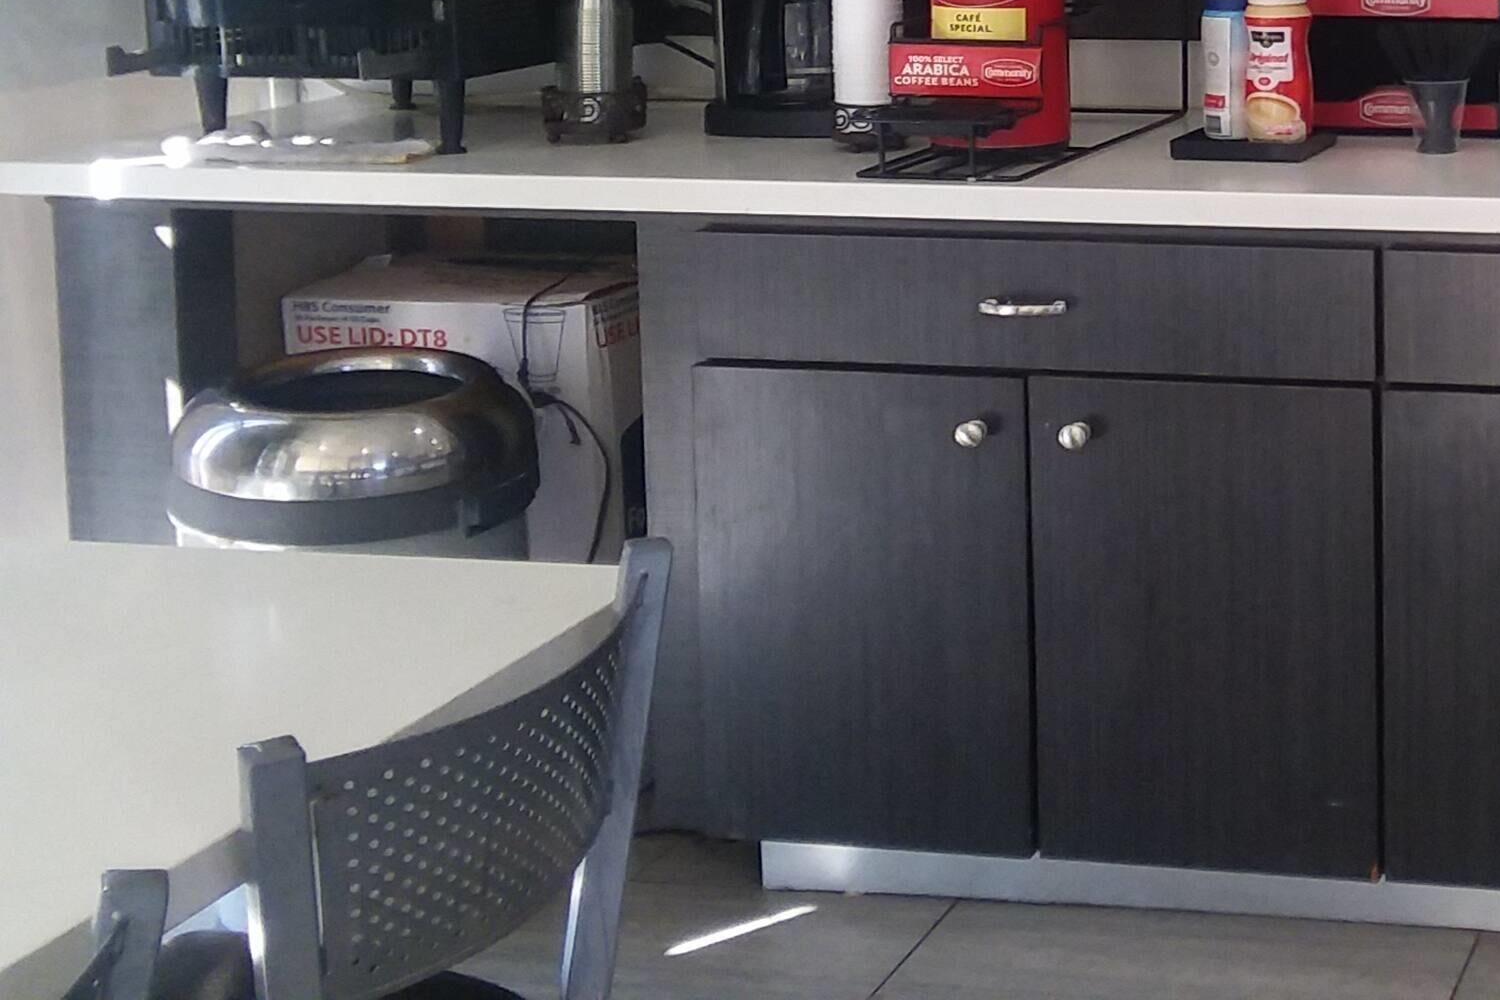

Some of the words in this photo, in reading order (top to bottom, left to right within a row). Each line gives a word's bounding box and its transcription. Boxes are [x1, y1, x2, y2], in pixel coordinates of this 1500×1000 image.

[956, 12, 981, 22] CAFÉ
[950, 24, 992, 33] SPECIAL
[908, 55, 931, 63] 100%
[933, 55, 964, 64] SELECT
[902, 63, 970, 76] ARABICA
[894, 76, 938, 86] COFFEE
[941, 77, 979, 88] BEANS
[297, 326, 341, 344] USE
[348, 326, 394, 346] LID:
[400, 328, 448, 348] DT8
